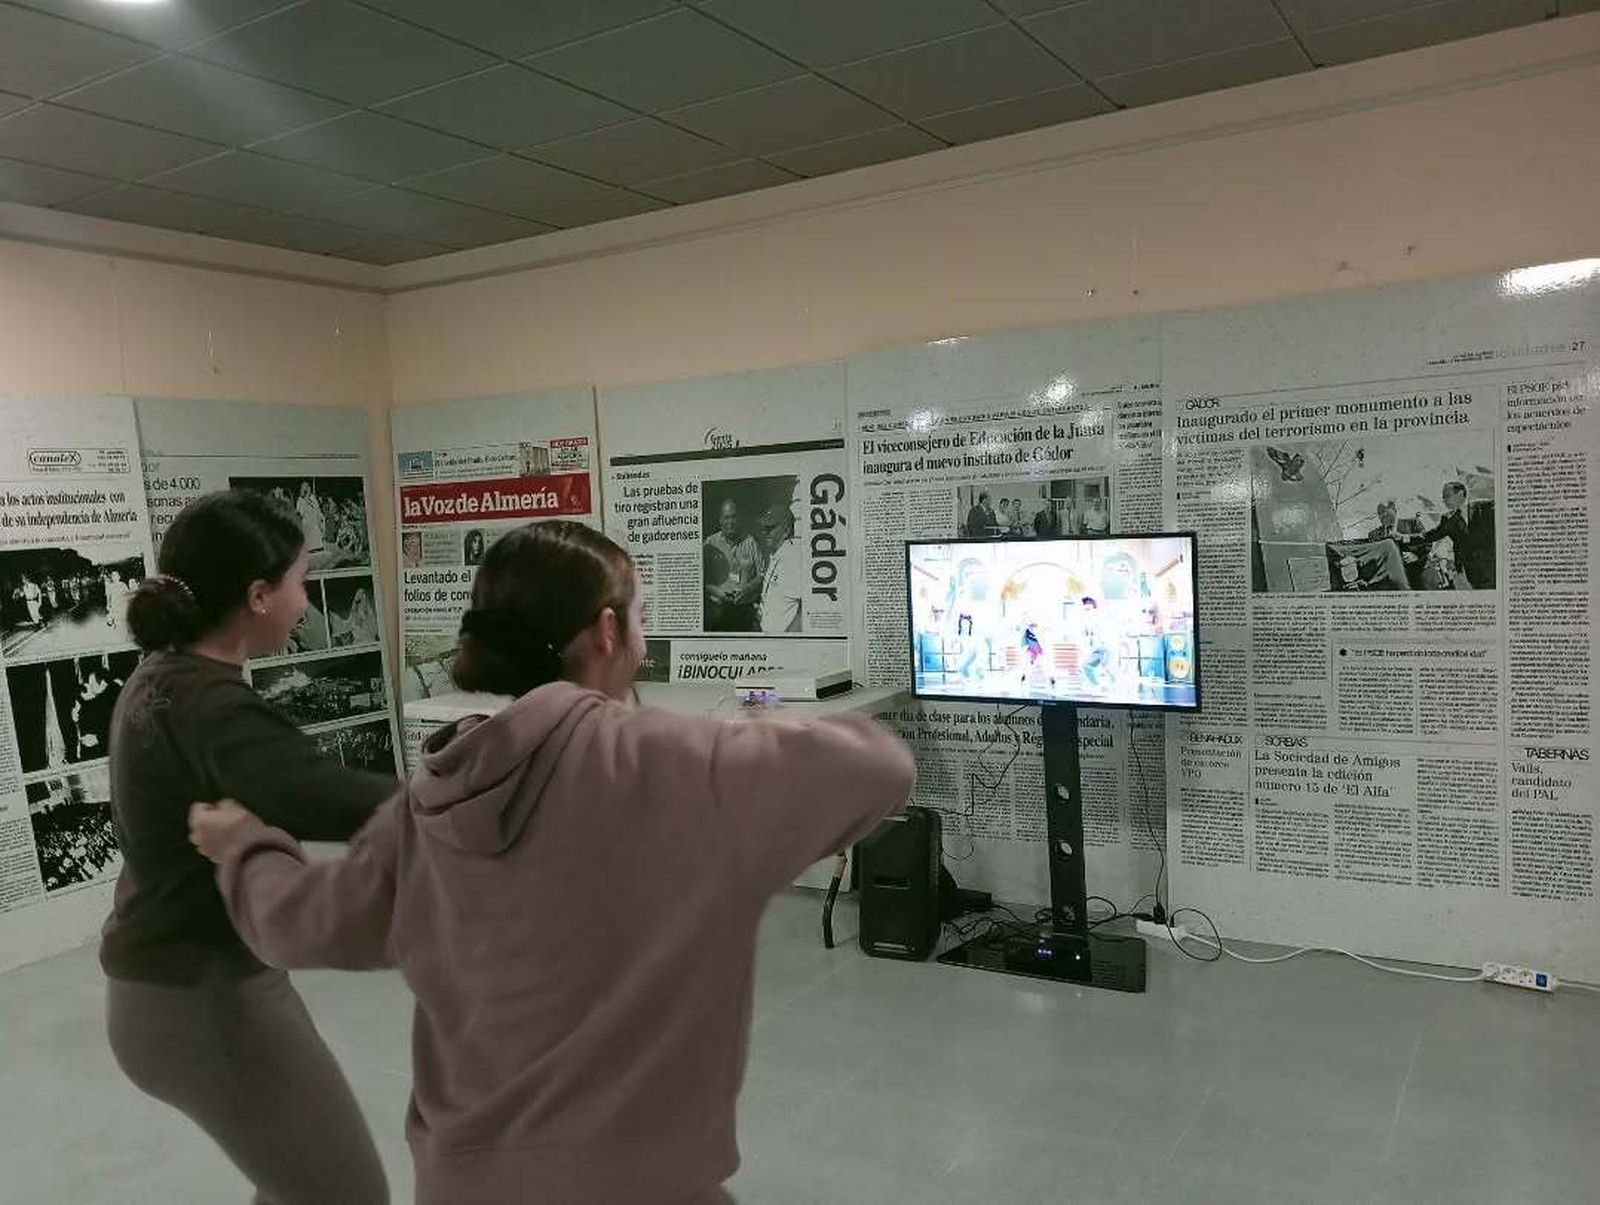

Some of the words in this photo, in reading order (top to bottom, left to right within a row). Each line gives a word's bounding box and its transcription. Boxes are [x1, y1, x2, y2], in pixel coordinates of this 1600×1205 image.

[1571, 340, 1585, 352] 27
[1177, 411, 1258, 429] Inaugurado
[1262, 408, 1275, 421] el
[1280, 404, 1331, 423] primer
[1336, 395, 1429, 415] monumento
[1433, 396, 1443, 407] a
[1448, 392, 1473, 406] las
[1239, 426, 1260, 440] del
[1265, 419, 1346, 439] terrorismo
[1350, 421, 1368, 432] en
[1373, 416, 1388, 430] la
[1393, 410, 1470, 433] provincia
[863, 440, 875, 455] El
[877, 435, 951, 454] viceconsejero
[952, 432, 966, 448] de
[969, 425, 1032, 446] Educación
[1035, 424, 1051, 441] de
[1053, 424, 1065, 440] la
[1067, 422, 1104, 439] Junta
[863, 460, 913, 477] inaugura
[914, 456, 924, 471] el
[926, 458, 961, 470] nuevo
[963, 449, 1013, 467] instituto
[1015, 447, 1030, 463] de
[152, 478, 169, 490] de
[169, 477, 201, 490] 4.000
[623, 485, 641, 498] Las
[643, 483, 684, 498] pruebas
[685, 481, 698, 493] de
[46, 489, 107, 505] institucionales
[109, 491, 126, 503] con
[146, 496, 182, 508] sonas
[480, 486, 559, 513] Almería
[614, 500, 632, 512] tiro
[633, 498, 677, 514] registran
[679, 499, 699, 510] una
[2, 513, 13, 527] de
[27, 511, 89, 530] independencia
[91, 510, 102, 523] de
[103, 508, 138, 523] Almería
[627, 517, 650, 530] gran
[651, 514, 699, 526] afluencia
[627, 531, 641, 543] de
[642, 528, 700, 544] gadorenses
[809, 473, 847, 602] Gádor
[404, 569, 458, 584] Levantado
[461, 569, 472, 583] el
[404, 588, 431, 602] folios
[434, 588, 447, 601] de
[928, 708, 951, 722] clase
[953, 712, 976, 726] para
[977, 711, 991, 723] los
[1077, 734, 1114, 750] special
[1264, 735, 1308, 747] SORBAS
[1255, 749, 1270, 761] La
[1274, 750, 1329, 764] Sociedad
[1333, 753, 1348, 765] de
[1352, 754, 1401, 769] Amigos
[1524, 747, 1590, 761] TABERNAS
[1255, 766, 1307, 778] presenta
[1312, 766, 1324, 778] la
[1328, 768, 1373, 782] edición
[1511, 775, 1572, 788] candidato
[1306, 782, 1319, 793] 15
[1323, 783, 1338, 794] de
